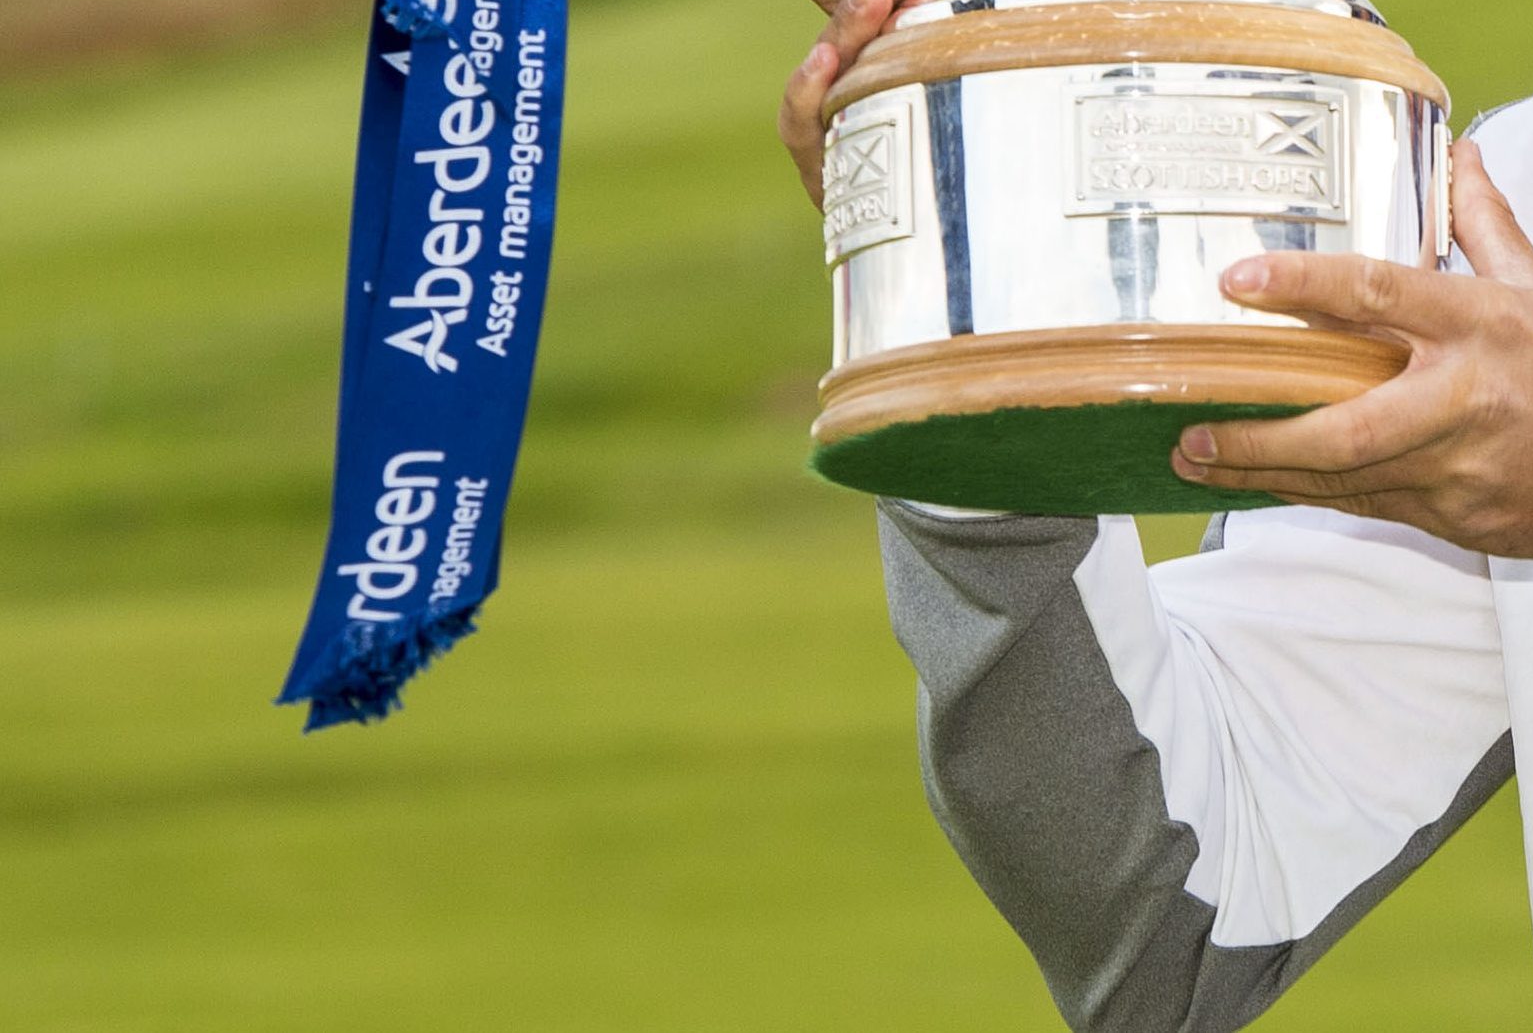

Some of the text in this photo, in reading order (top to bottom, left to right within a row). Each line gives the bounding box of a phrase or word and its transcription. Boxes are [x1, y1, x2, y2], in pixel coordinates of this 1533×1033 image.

[384, 38, 497, 374] Aberdee
[476, 29, 546, 357] Asset management
[1090, 163, 1327, 195] SCOTTISH OPEN
[1091, 103, 1252, 139] Aberdeen
[337, 451, 445, 623] rdeen
